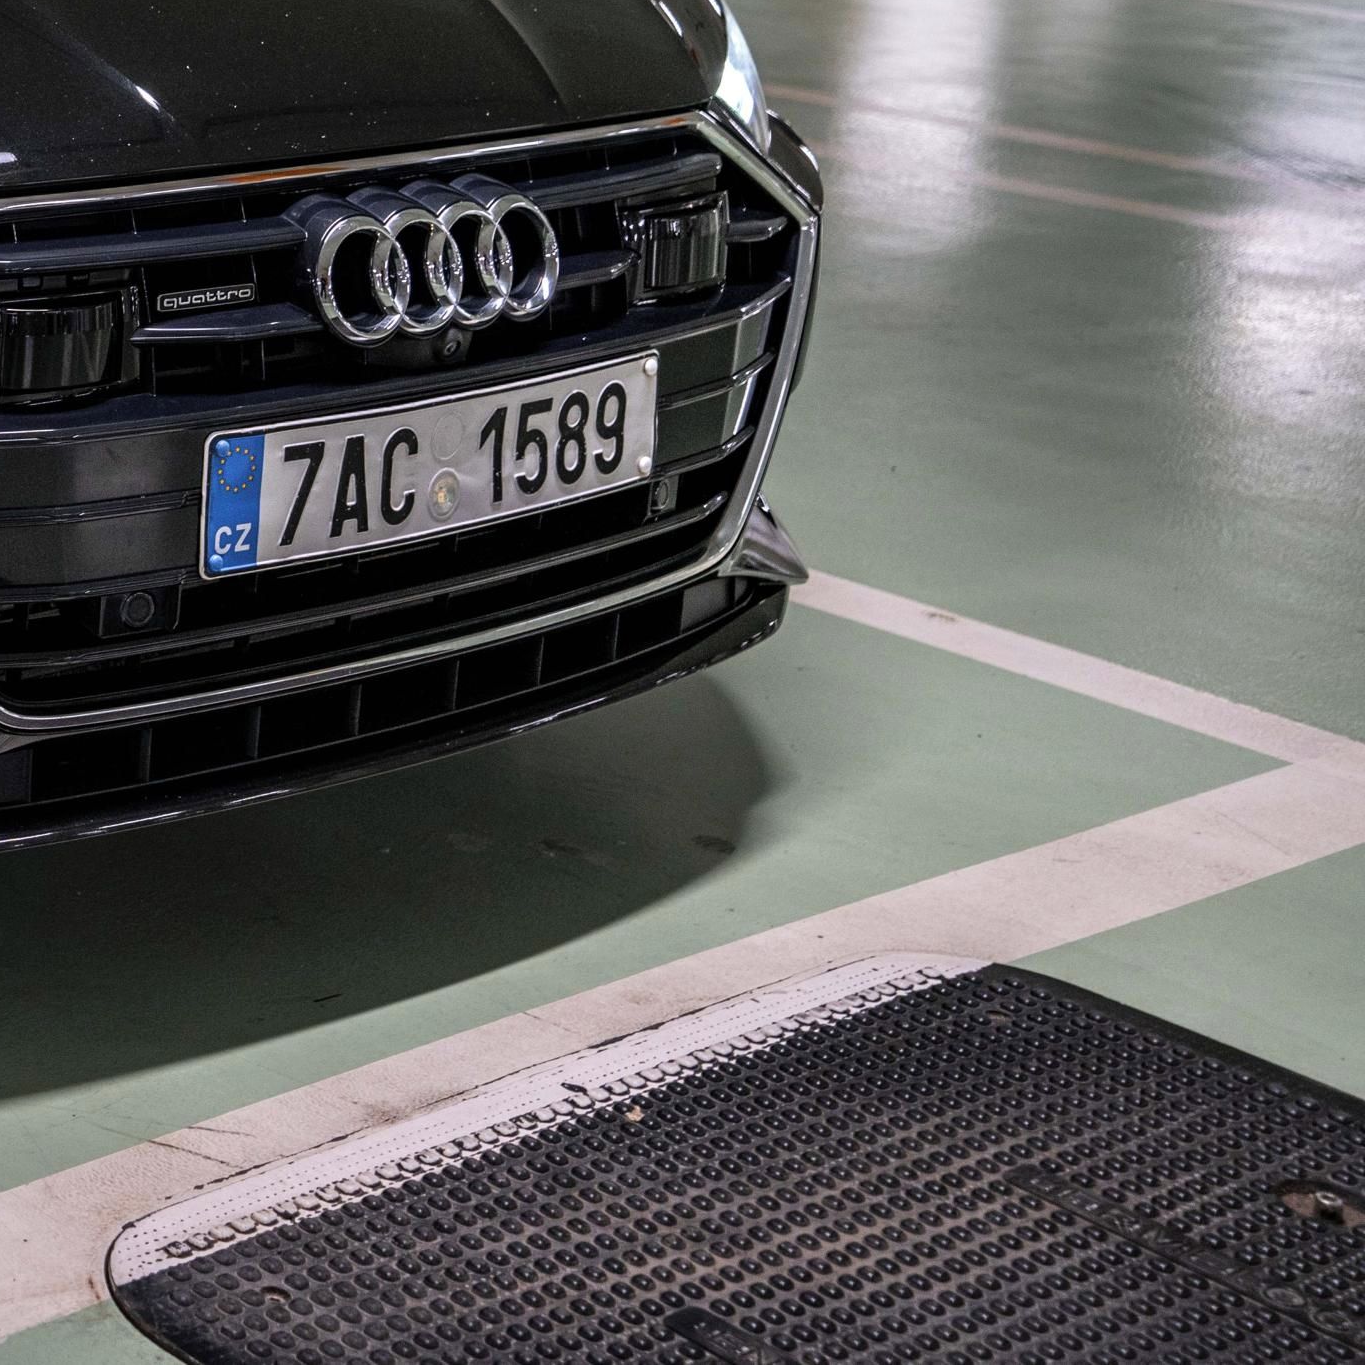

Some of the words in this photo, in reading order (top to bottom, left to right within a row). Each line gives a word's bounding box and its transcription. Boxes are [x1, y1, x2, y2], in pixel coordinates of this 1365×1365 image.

[163, 288, 252, 309] quattro
[279, 427, 419, 547] 7AC
[478, 380, 627, 504] 1589
[213, 521, 253, 555] CZ
